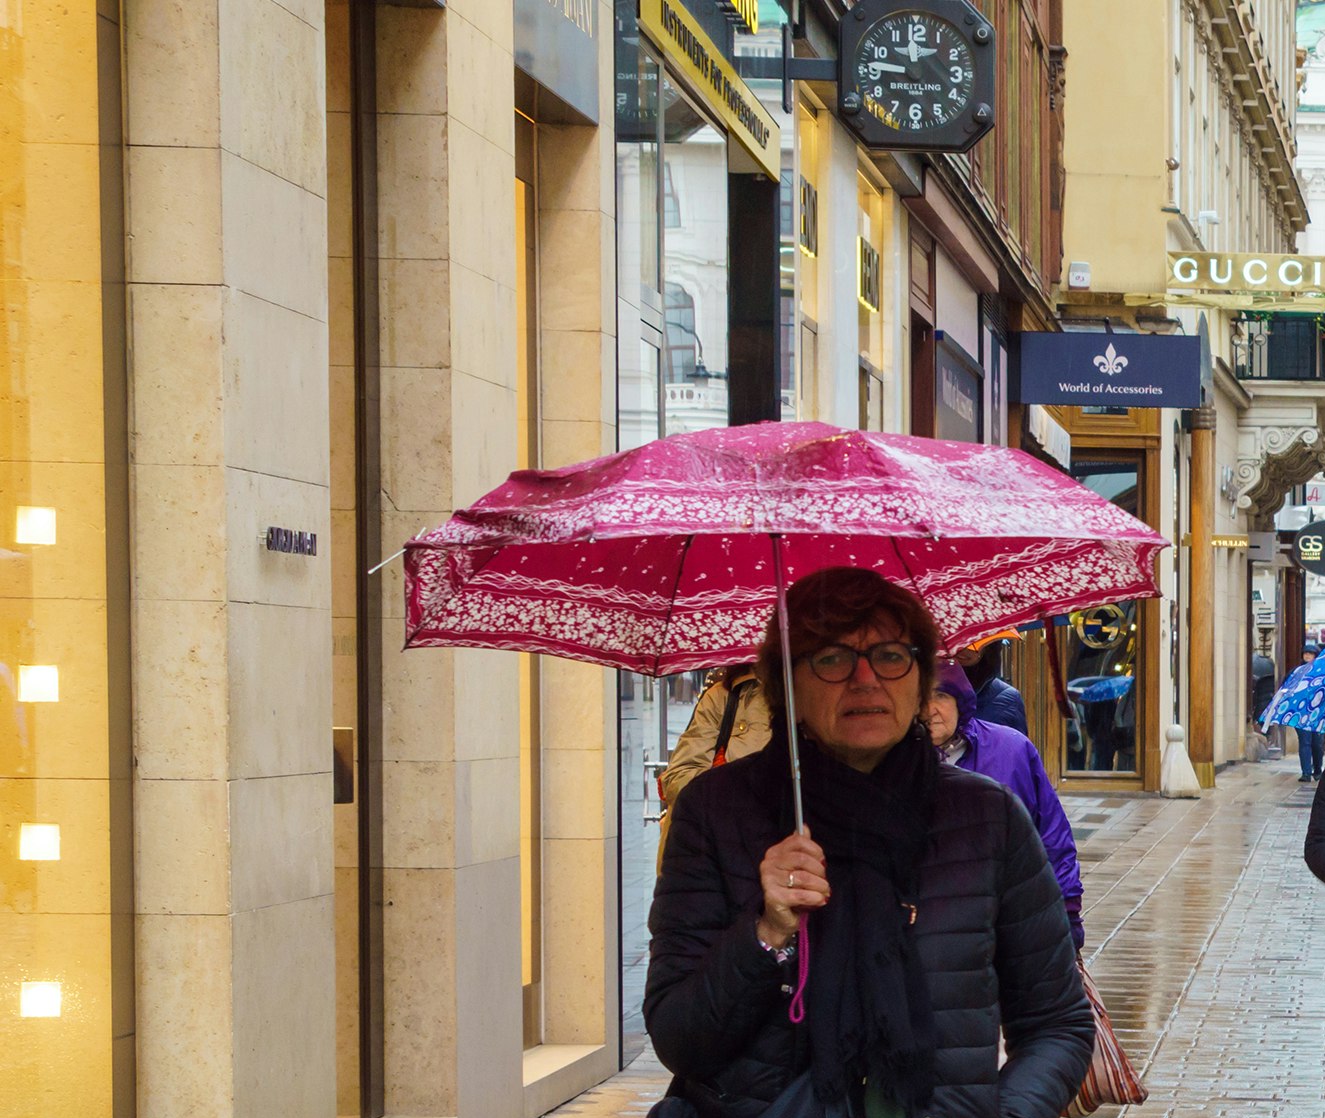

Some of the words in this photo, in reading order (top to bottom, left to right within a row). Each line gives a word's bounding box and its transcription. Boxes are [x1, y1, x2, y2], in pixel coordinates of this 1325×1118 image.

[908, 24, 926, 41] 12
[874, 46, 888, 59] 10
[949, 48, 959, 60] 2
[950, 66, 963, 83] 3
[874, 85, 883, 98] 8
[890, 82, 941, 92] BREITLING
[948, 88, 958, 100] 4
[891, 100, 899, 113] 7
[909, 103, 922, 120] 6
[933, 104, 942, 116] 5
[1173, 257, 1322, 287] GUCCI
[1058, 382, 1090, 393] World
[1092, 382, 1104, 393] of
[1105, 383, 1163, 395] Accessories
[1298, 535, 1323, 552] GS
